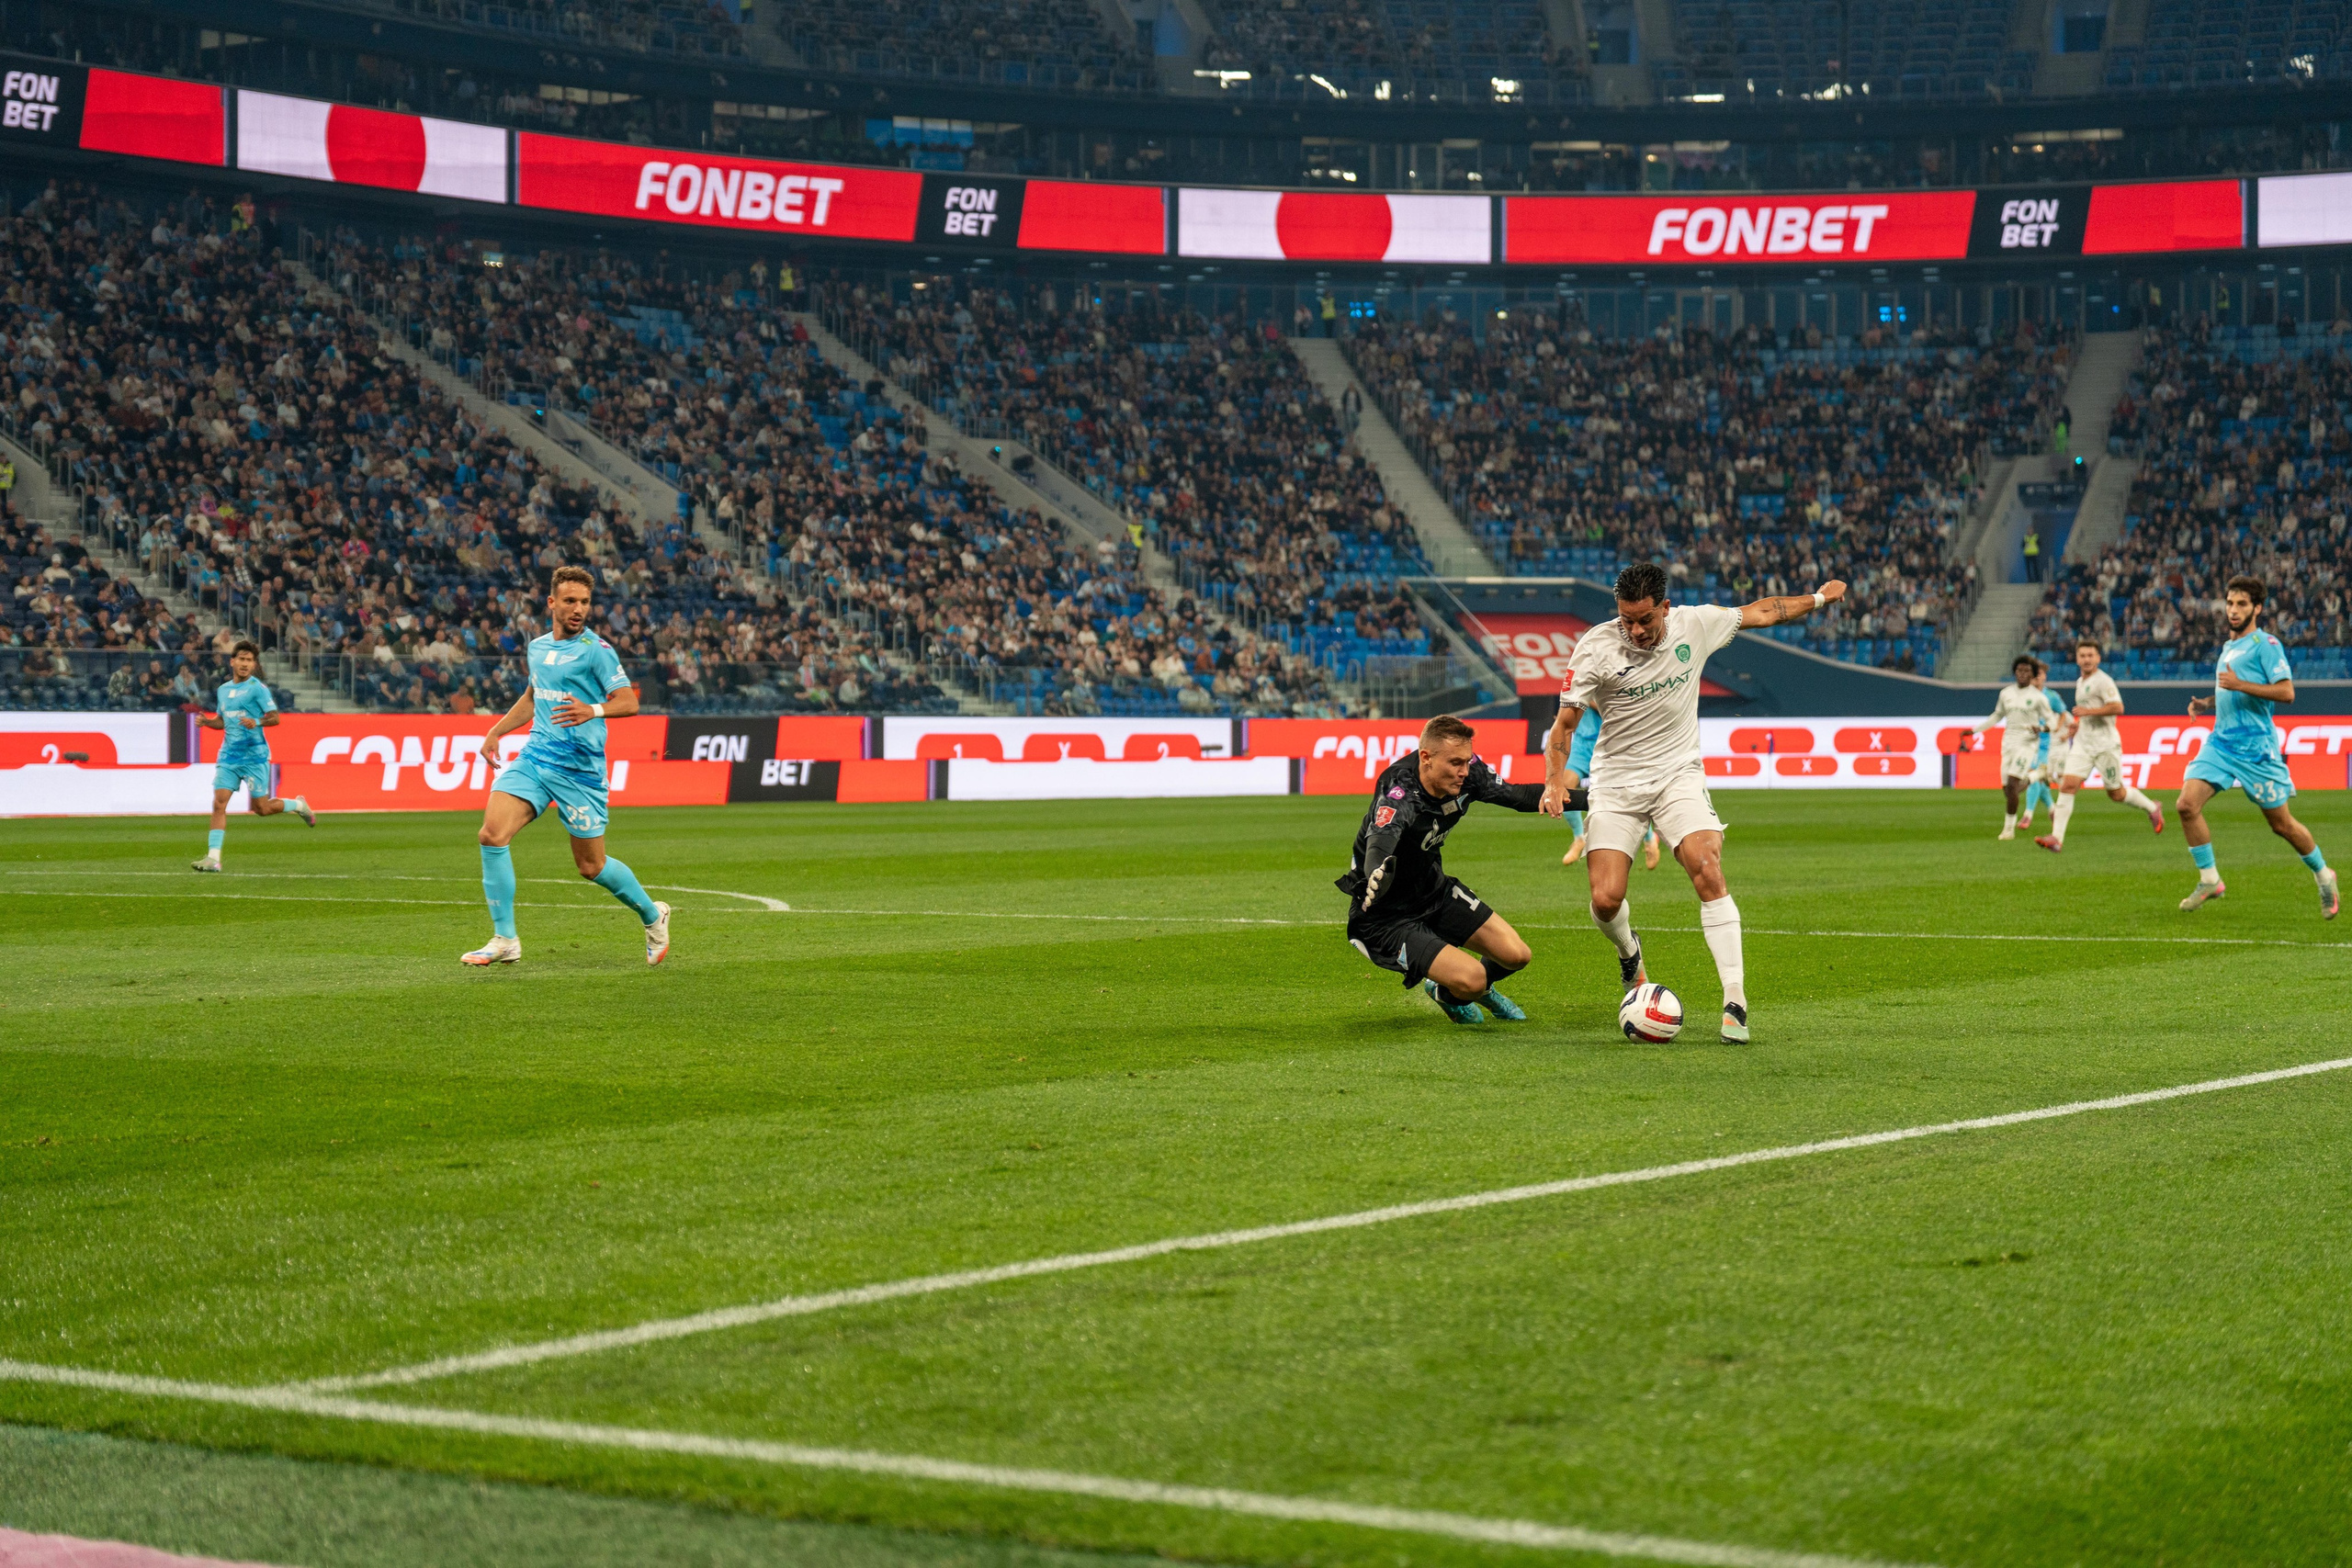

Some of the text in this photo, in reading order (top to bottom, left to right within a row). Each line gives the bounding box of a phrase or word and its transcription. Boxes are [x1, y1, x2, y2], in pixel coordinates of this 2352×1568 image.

[3, 70, 60, 103] FON
[2, 99, 60, 131] BET
[635, 161, 843, 226] FONBET
[944, 186, 998, 212] FON
[944, 211, 998, 237] BET
[2000, 198, 2059, 224] FON
[1647, 205, 1888, 255] FONBET
[2000, 222, 2059, 248] BET
[1504, 656, 1567, 680] BE
[1616, 668, 1693, 697] AKHMAT
[692, 735, 750, 762] FON
[1869, 731, 1984, 750] X 2
[761, 759, 816, 786] BET
[1724, 761, 1732, 773] 1
[1802, 760, 1813, 773] X
[2253, 780, 2277, 803] 23
[566, 806, 591, 831] 25
[1452, 885, 1480, 911] 1
